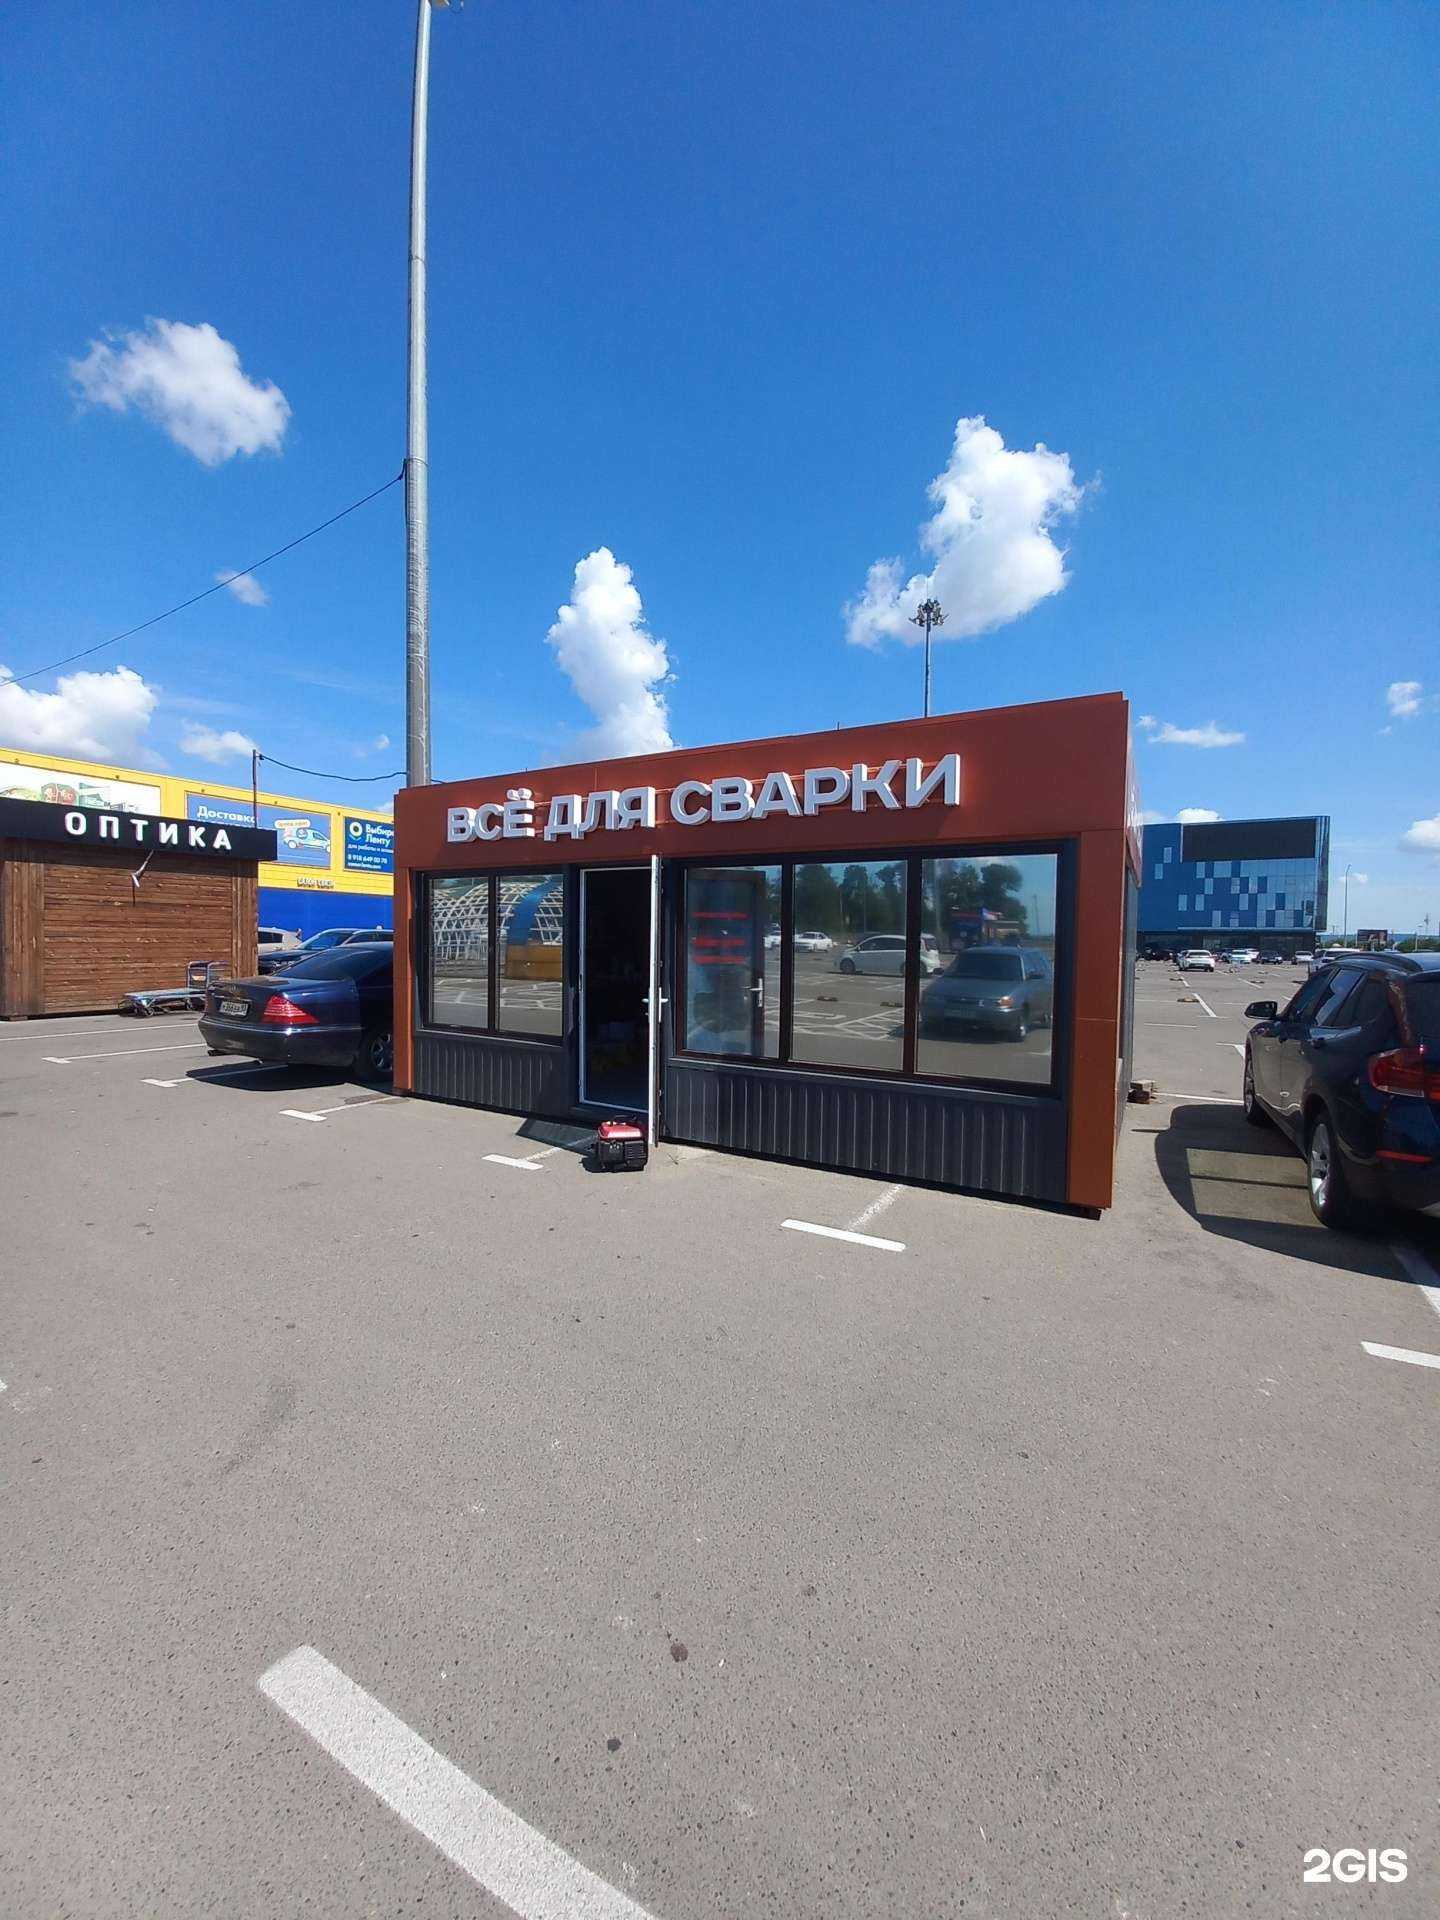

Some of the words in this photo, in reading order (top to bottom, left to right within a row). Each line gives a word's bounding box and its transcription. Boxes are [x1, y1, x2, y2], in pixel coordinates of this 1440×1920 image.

[446, 788, 535, 843] ВСЁ
[543, 785, 655, 841] ДЛЯ
[670, 753, 961, 826] СВАРКИ
[64, 811, 232, 850] ОПТИКА
[365, 834, 391, 848] Ленту
